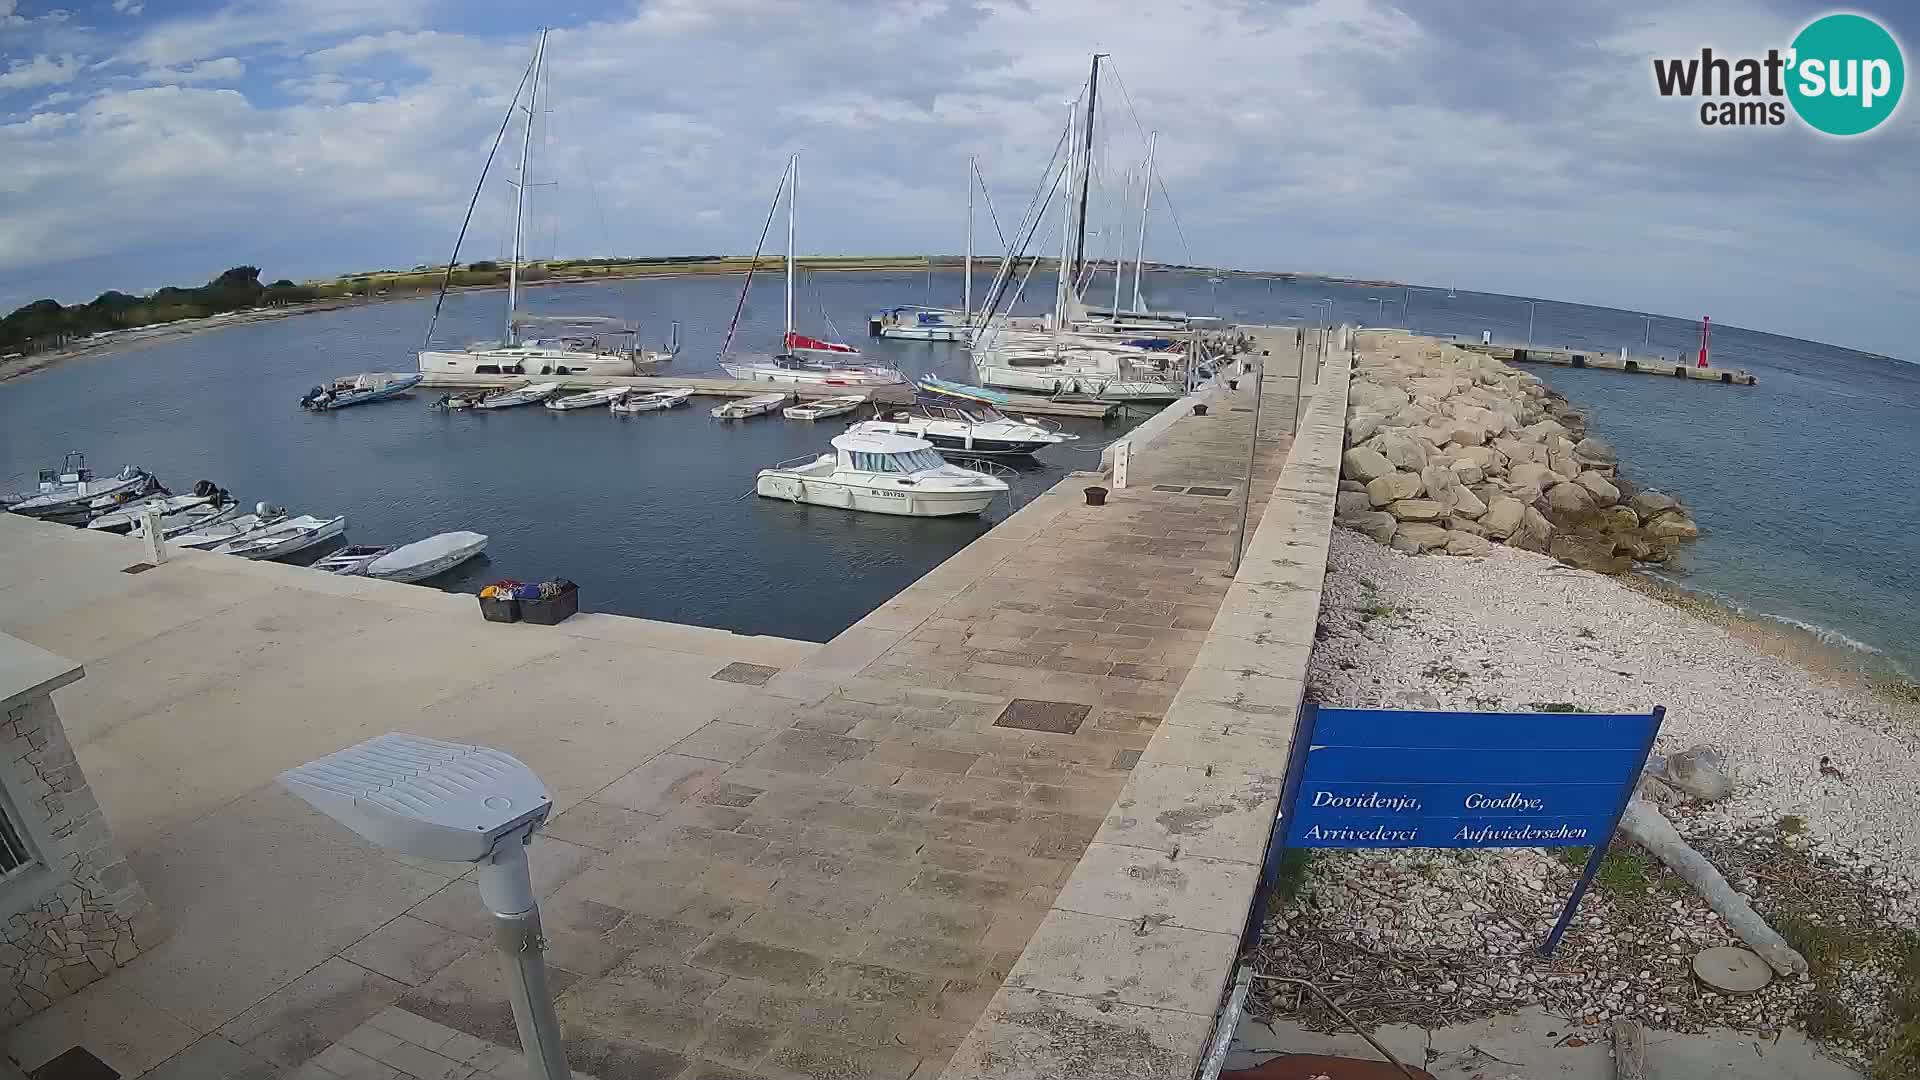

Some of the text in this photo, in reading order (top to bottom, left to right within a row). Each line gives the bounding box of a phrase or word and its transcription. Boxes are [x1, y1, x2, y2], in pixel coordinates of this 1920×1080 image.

[1465, 792, 1544, 811] Goodbye,
[1303, 824, 1418, 841] Arrivederci
[1452, 823, 1588, 843] Aufwiedersehen
